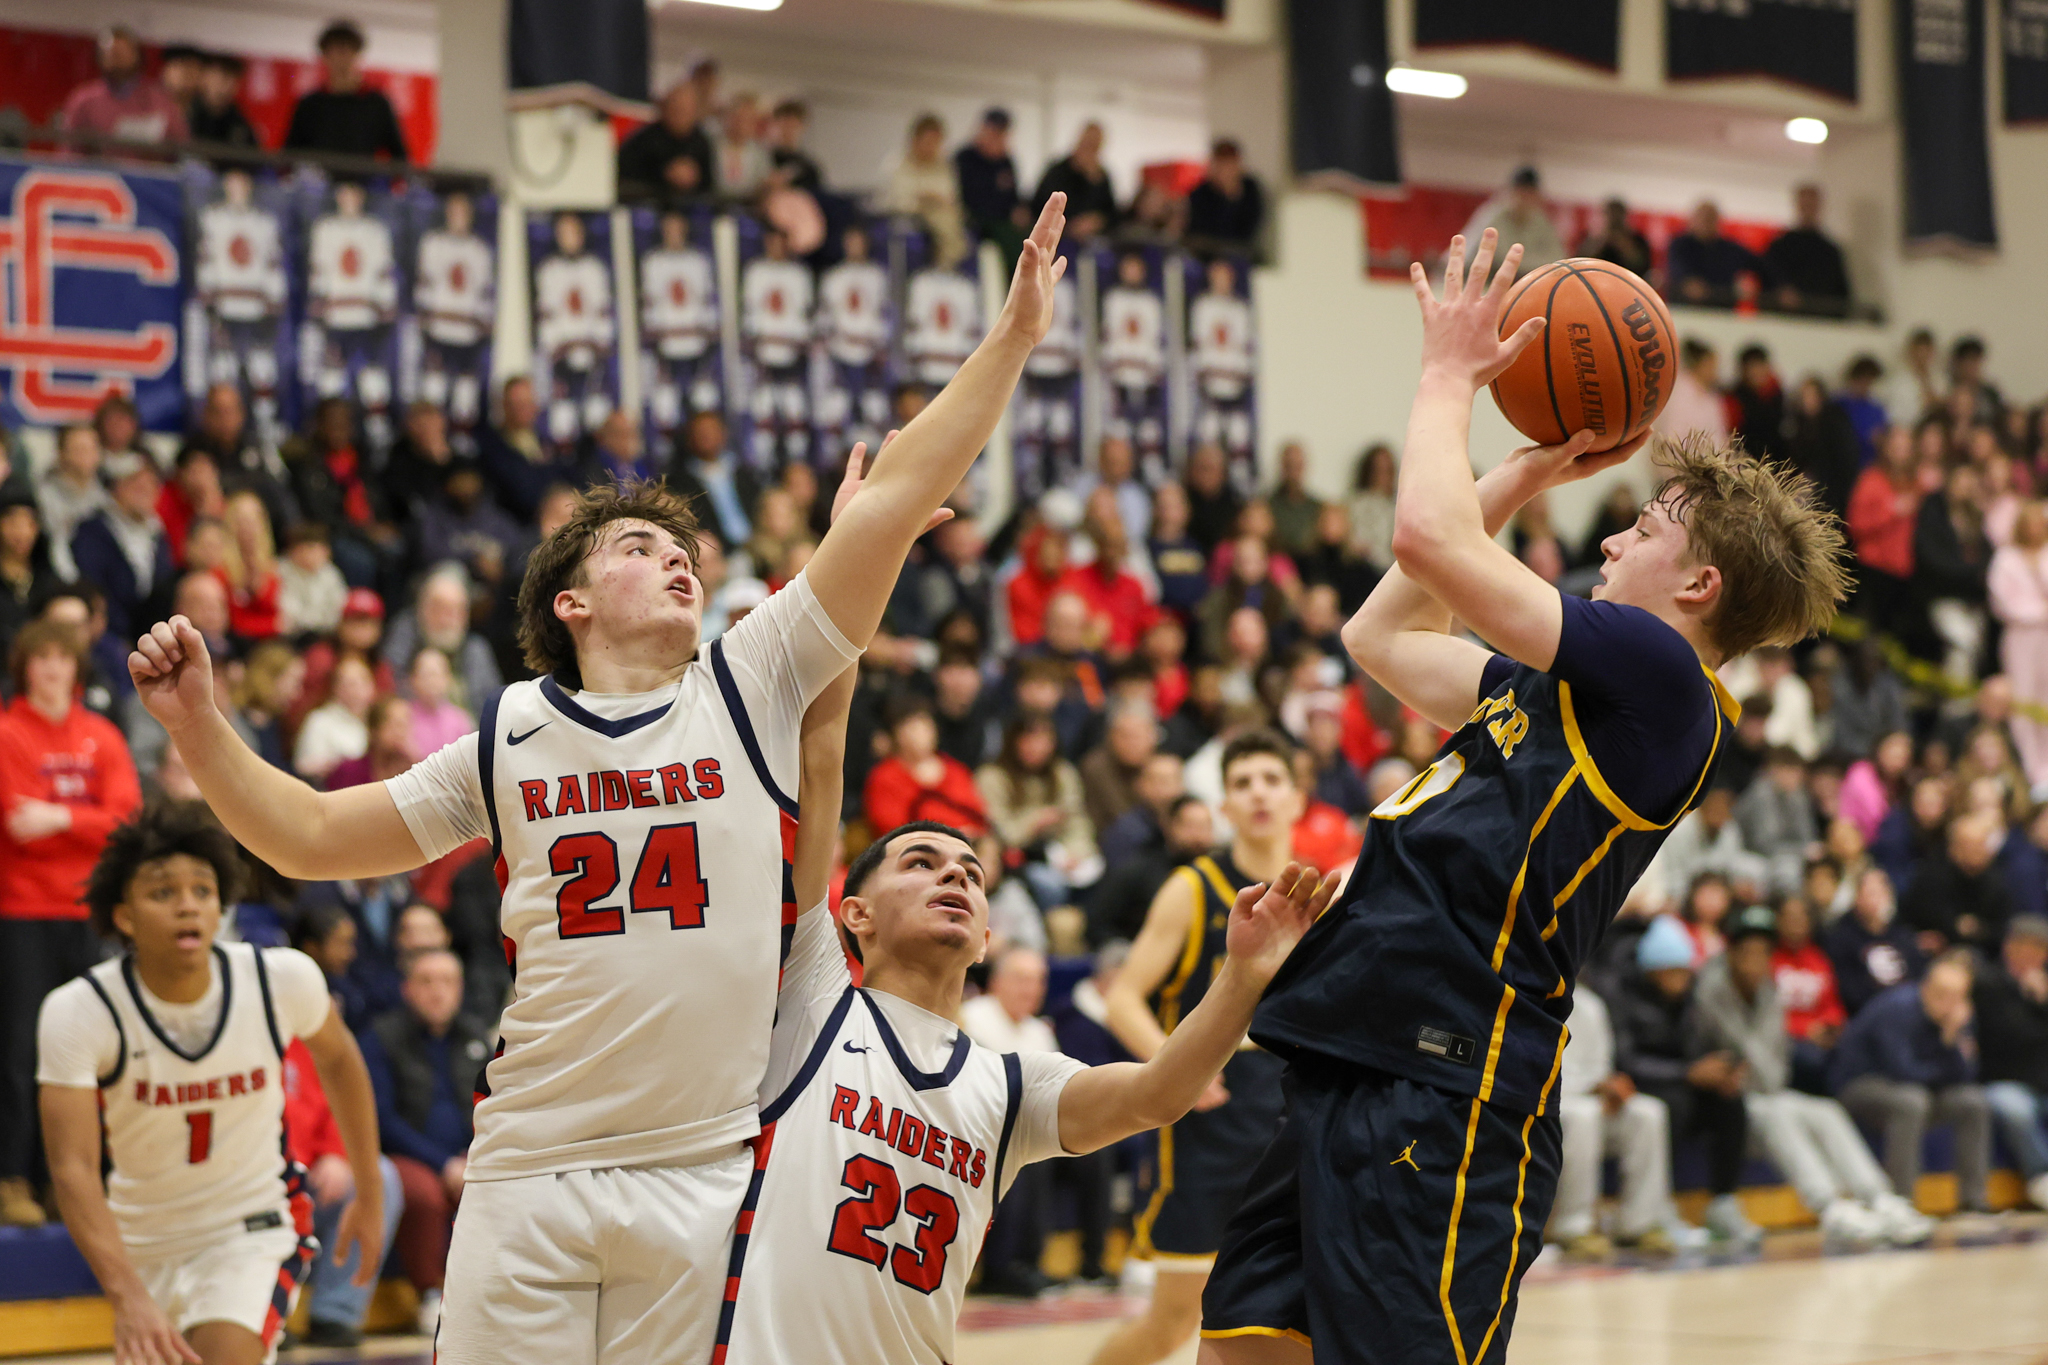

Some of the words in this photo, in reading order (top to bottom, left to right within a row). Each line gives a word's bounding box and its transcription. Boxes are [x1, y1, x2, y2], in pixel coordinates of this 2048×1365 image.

[1572, 322, 1607, 436] EVOLUTION
[1621, 298, 1666, 432] Wilson
[518, 757, 726, 822] RAIDERS
[547, 821, 710, 940] 24
[135, 1068, 266, 1106] RAIDERS
[1457, 1044, 1463, 1056] L
[185, 1109, 214, 1165] 1
[829, 1083, 987, 1189] RAIDERS
[826, 1152, 961, 1296] 23
